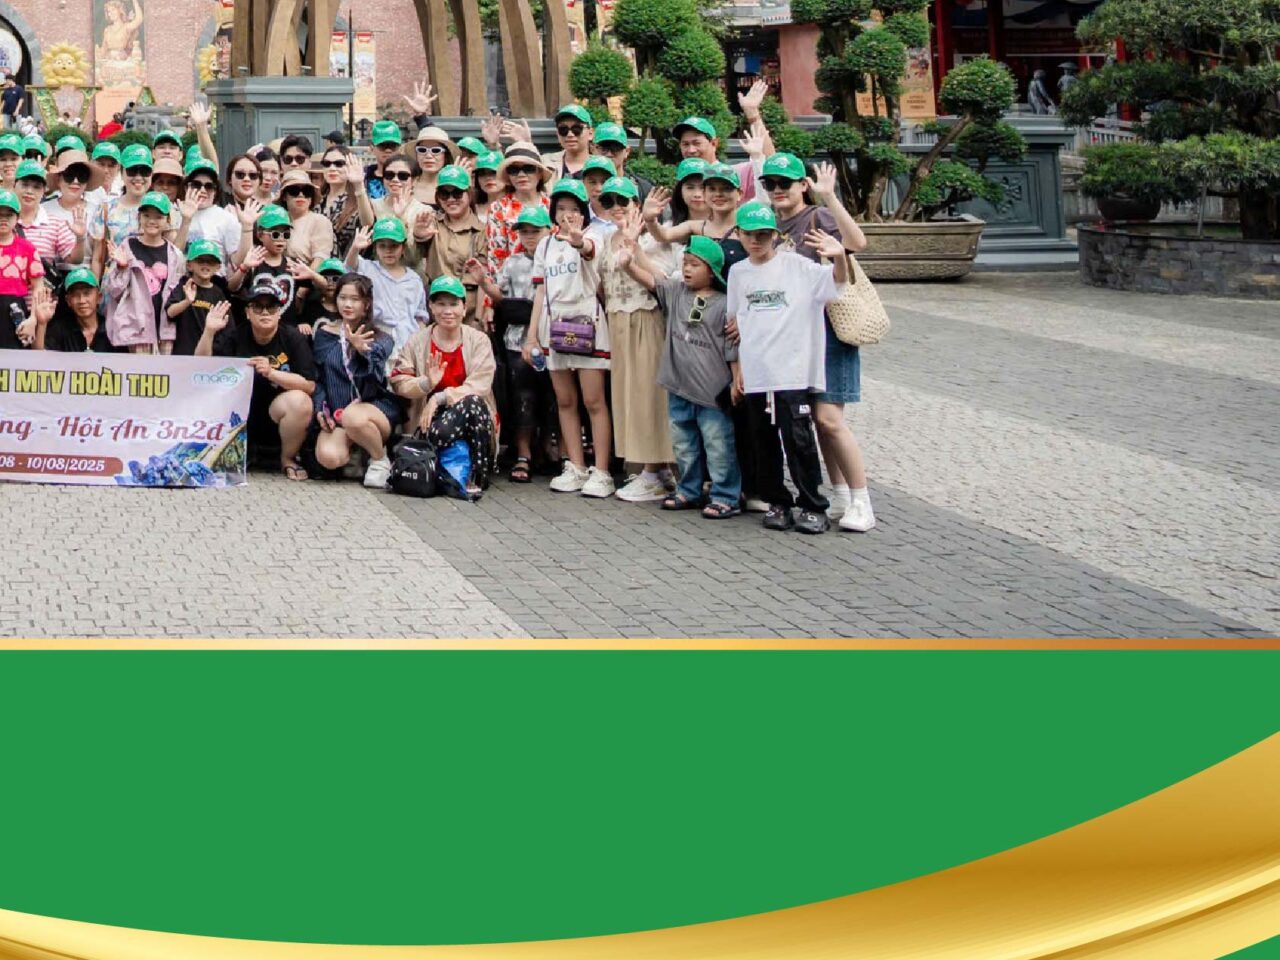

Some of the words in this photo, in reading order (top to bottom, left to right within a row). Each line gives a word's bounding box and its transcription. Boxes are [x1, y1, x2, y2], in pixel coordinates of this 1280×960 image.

[15, 369, 65, 394] MTV
[69, 367, 122, 397] HOÀI
[127, 373, 170, 398] THU
[57, 415, 104, 443] Hội
[110, 418, 150, 441] An
[26, 456, 106, 474] 10/08/2025
